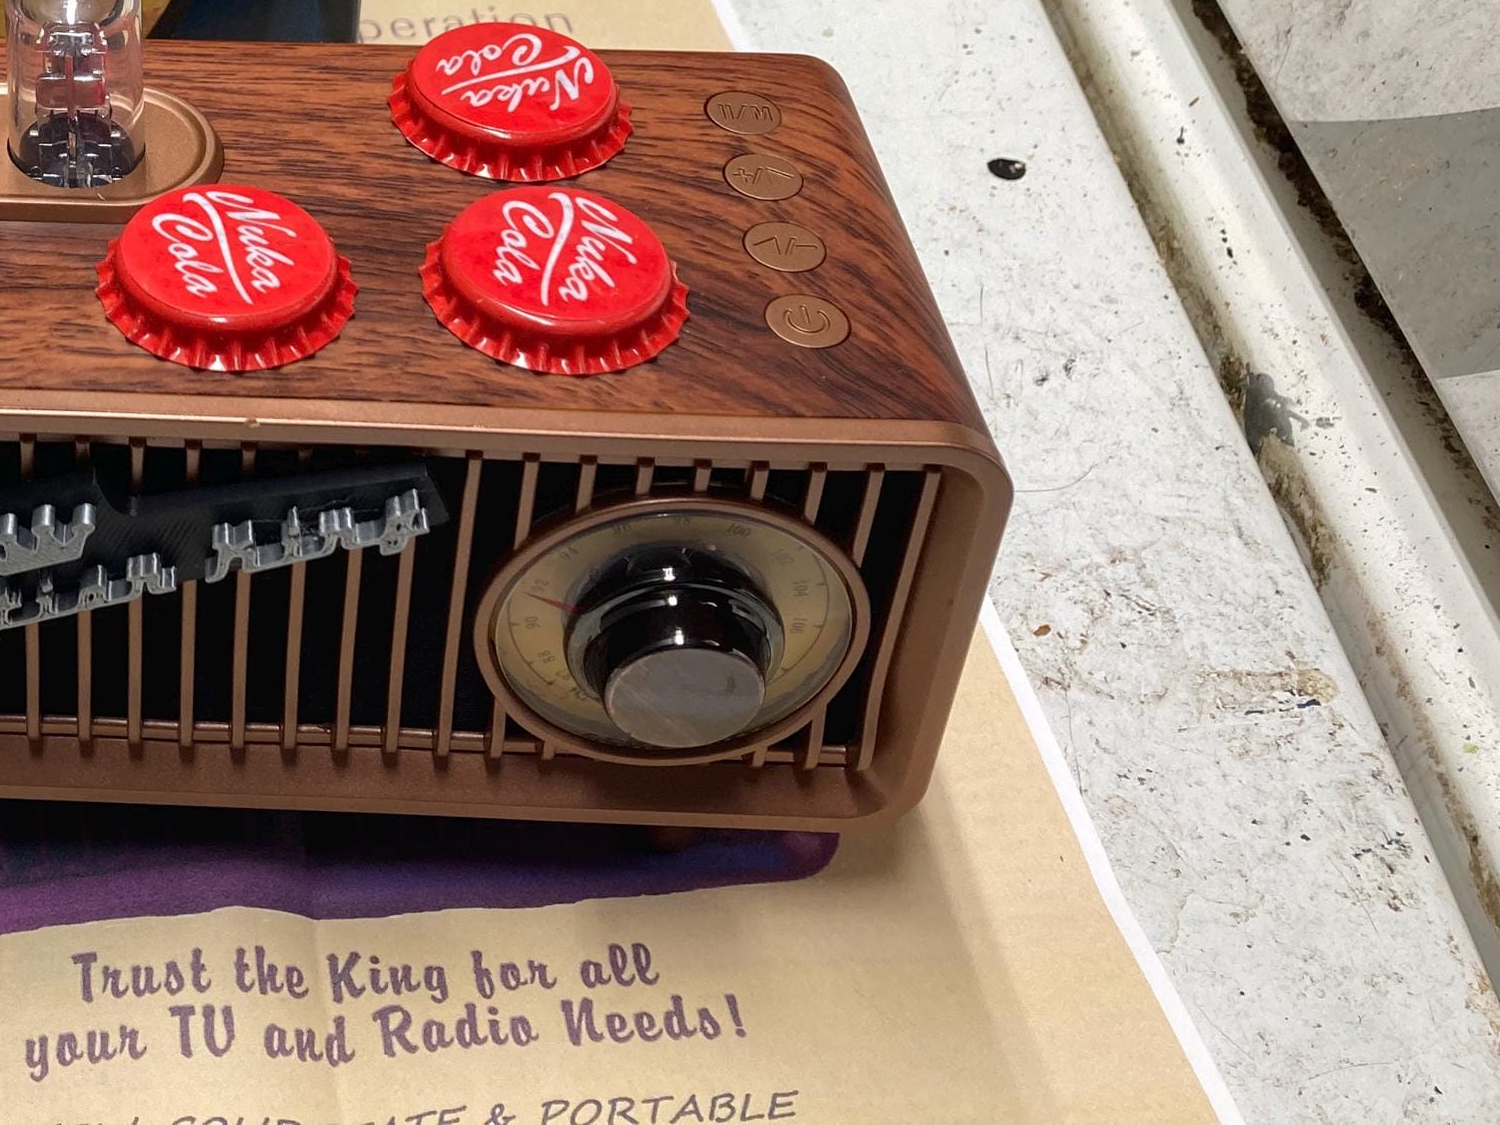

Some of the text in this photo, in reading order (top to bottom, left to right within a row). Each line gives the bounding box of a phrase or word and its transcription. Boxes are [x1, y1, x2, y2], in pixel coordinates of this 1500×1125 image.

[436, 32, 543, 76] Cola
[460, 56, 594, 112] Nuka
[152, 213, 224, 298] Cola
[205, 191, 298, 294] Nuka
[492, 200, 555, 286] Cola
[558, 195, 638, 303] Nuka
[72, 942, 660, 1004] Trust the King for all
[24, 1022, 148, 1082] your
[263, 1017, 355, 1068] and
[373, 1004, 540, 1057] Radio
[560, 992, 748, 1046] Needs!
[540, 1089, 800, 1125] PORTABLE
